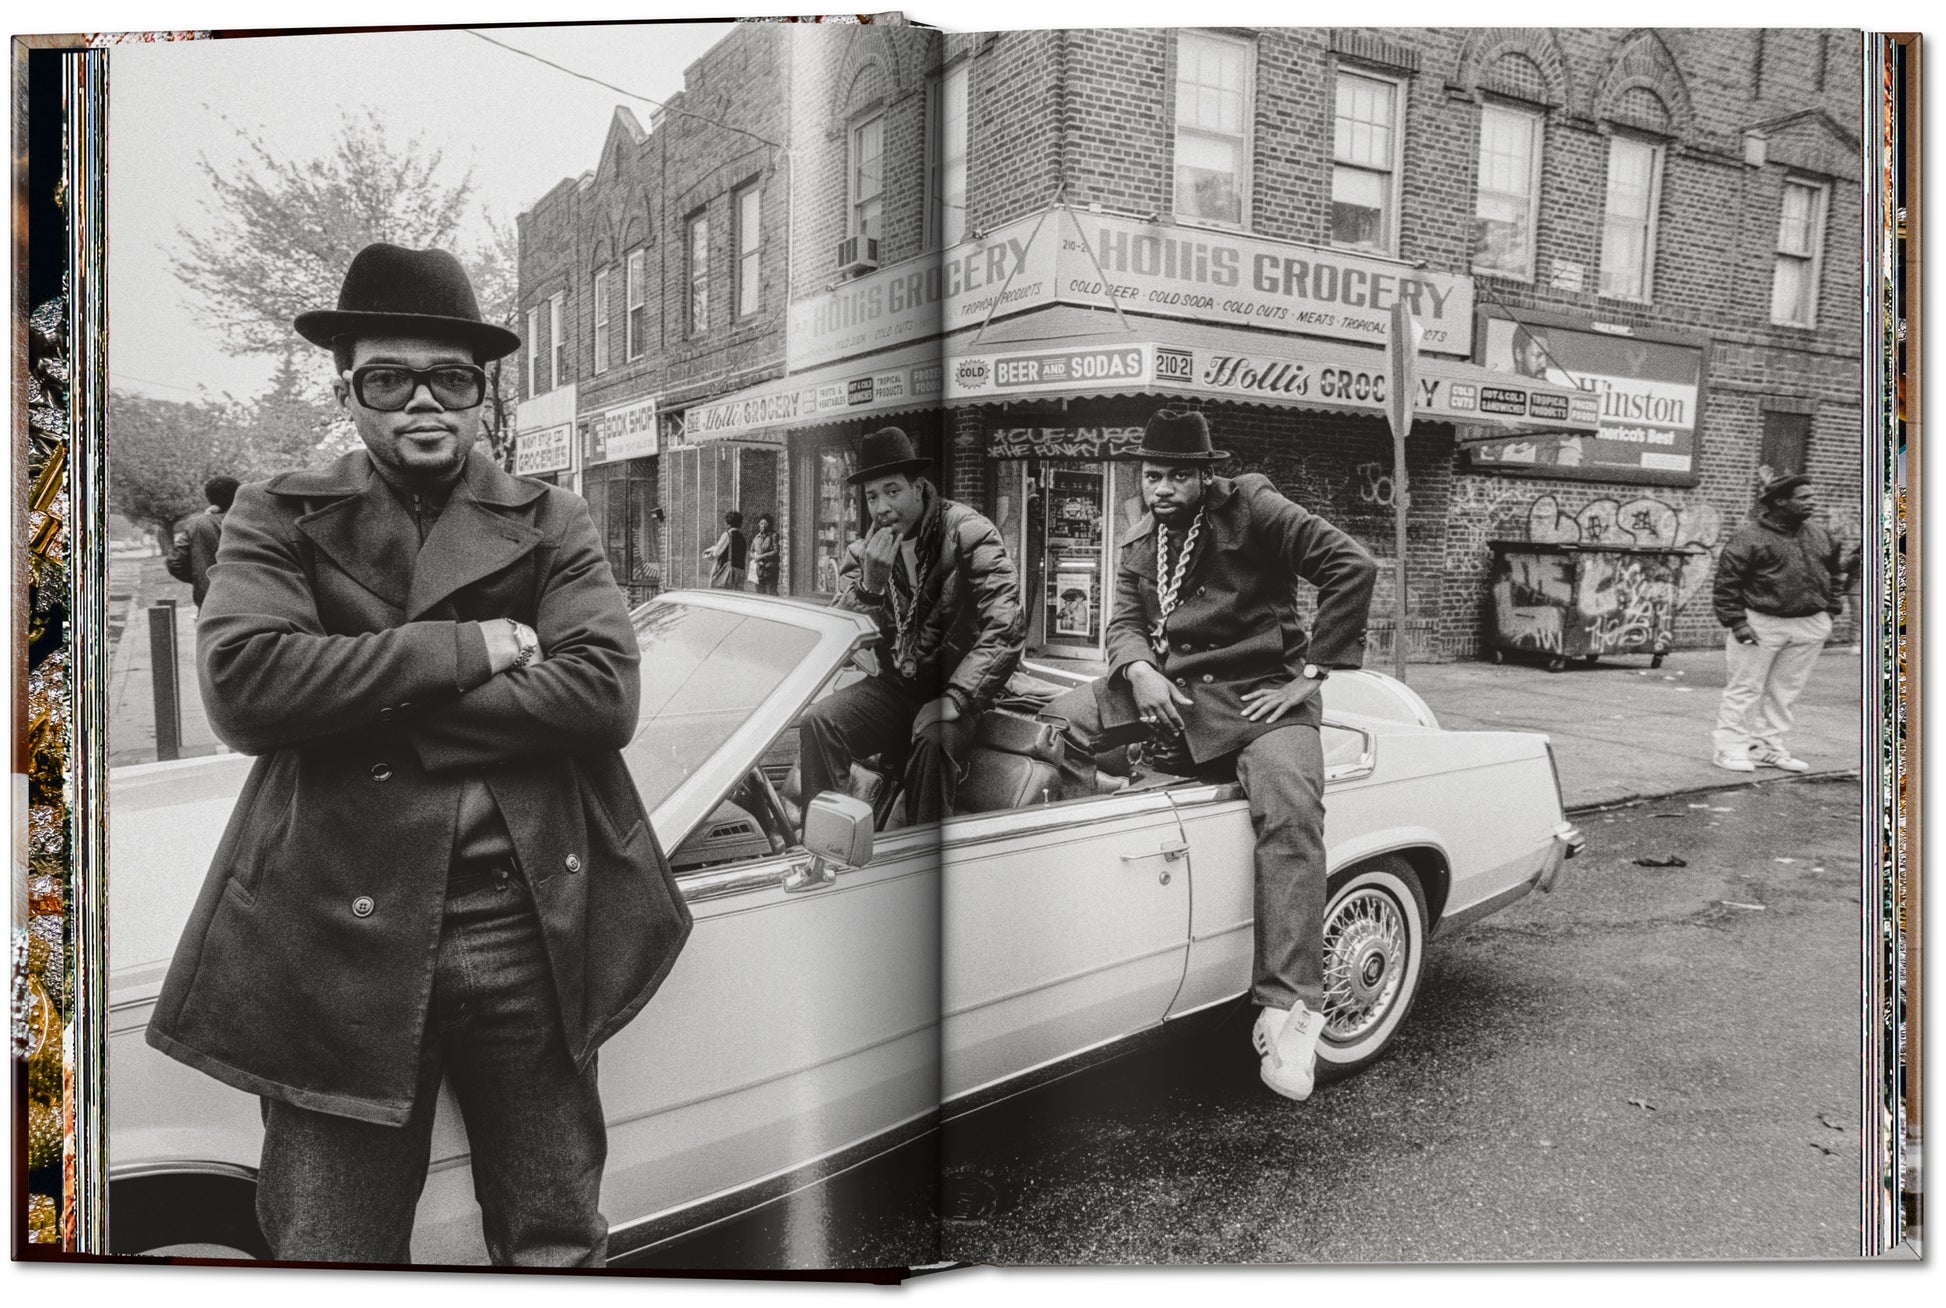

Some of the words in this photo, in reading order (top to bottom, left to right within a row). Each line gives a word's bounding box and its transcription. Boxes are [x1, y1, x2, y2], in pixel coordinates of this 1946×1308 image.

[888, 237, 1026, 314] GROCERY
[1253, 253, 1454, 319] GROCERY
[1000, 281, 1043, 305] PRODUCTS
[1069, 279, 1102, 295] COLD
[1104, 283, 1140, 300] BEER
[1149, 289, 1180, 305] COLD
[1181, 293, 1214, 310] SODA
[1222, 300, 1254, 315] COLD
[1255, 303, 1289, 320] CUTS
[1297, 311, 1335, 327] MEATS
[1340, 316, 1386, 335] TROPICAL
[959, 366, 985, 378] COLD
[998, 360, 1039, 384] BEER
[1043, 363, 1065, 375] AND
[1071, 353, 1140, 378] SODAS
[875, 384, 903, 398] PRODUCTS
[1203, 355, 1312, 396] Hollis
[1320, 368, 1440, 408] GROCY
[1451, 385, 1474, 397] COLD
[744, 391, 800, 424] GROCERY
[1451, 396, 1474, 409] CUTS
[1505, 391, 1525, 403] COLD
[1532, 393, 1567, 407] TROPICAL
[629, 405, 653, 434] SHOP
[1647, 428, 1675, 445] Best
